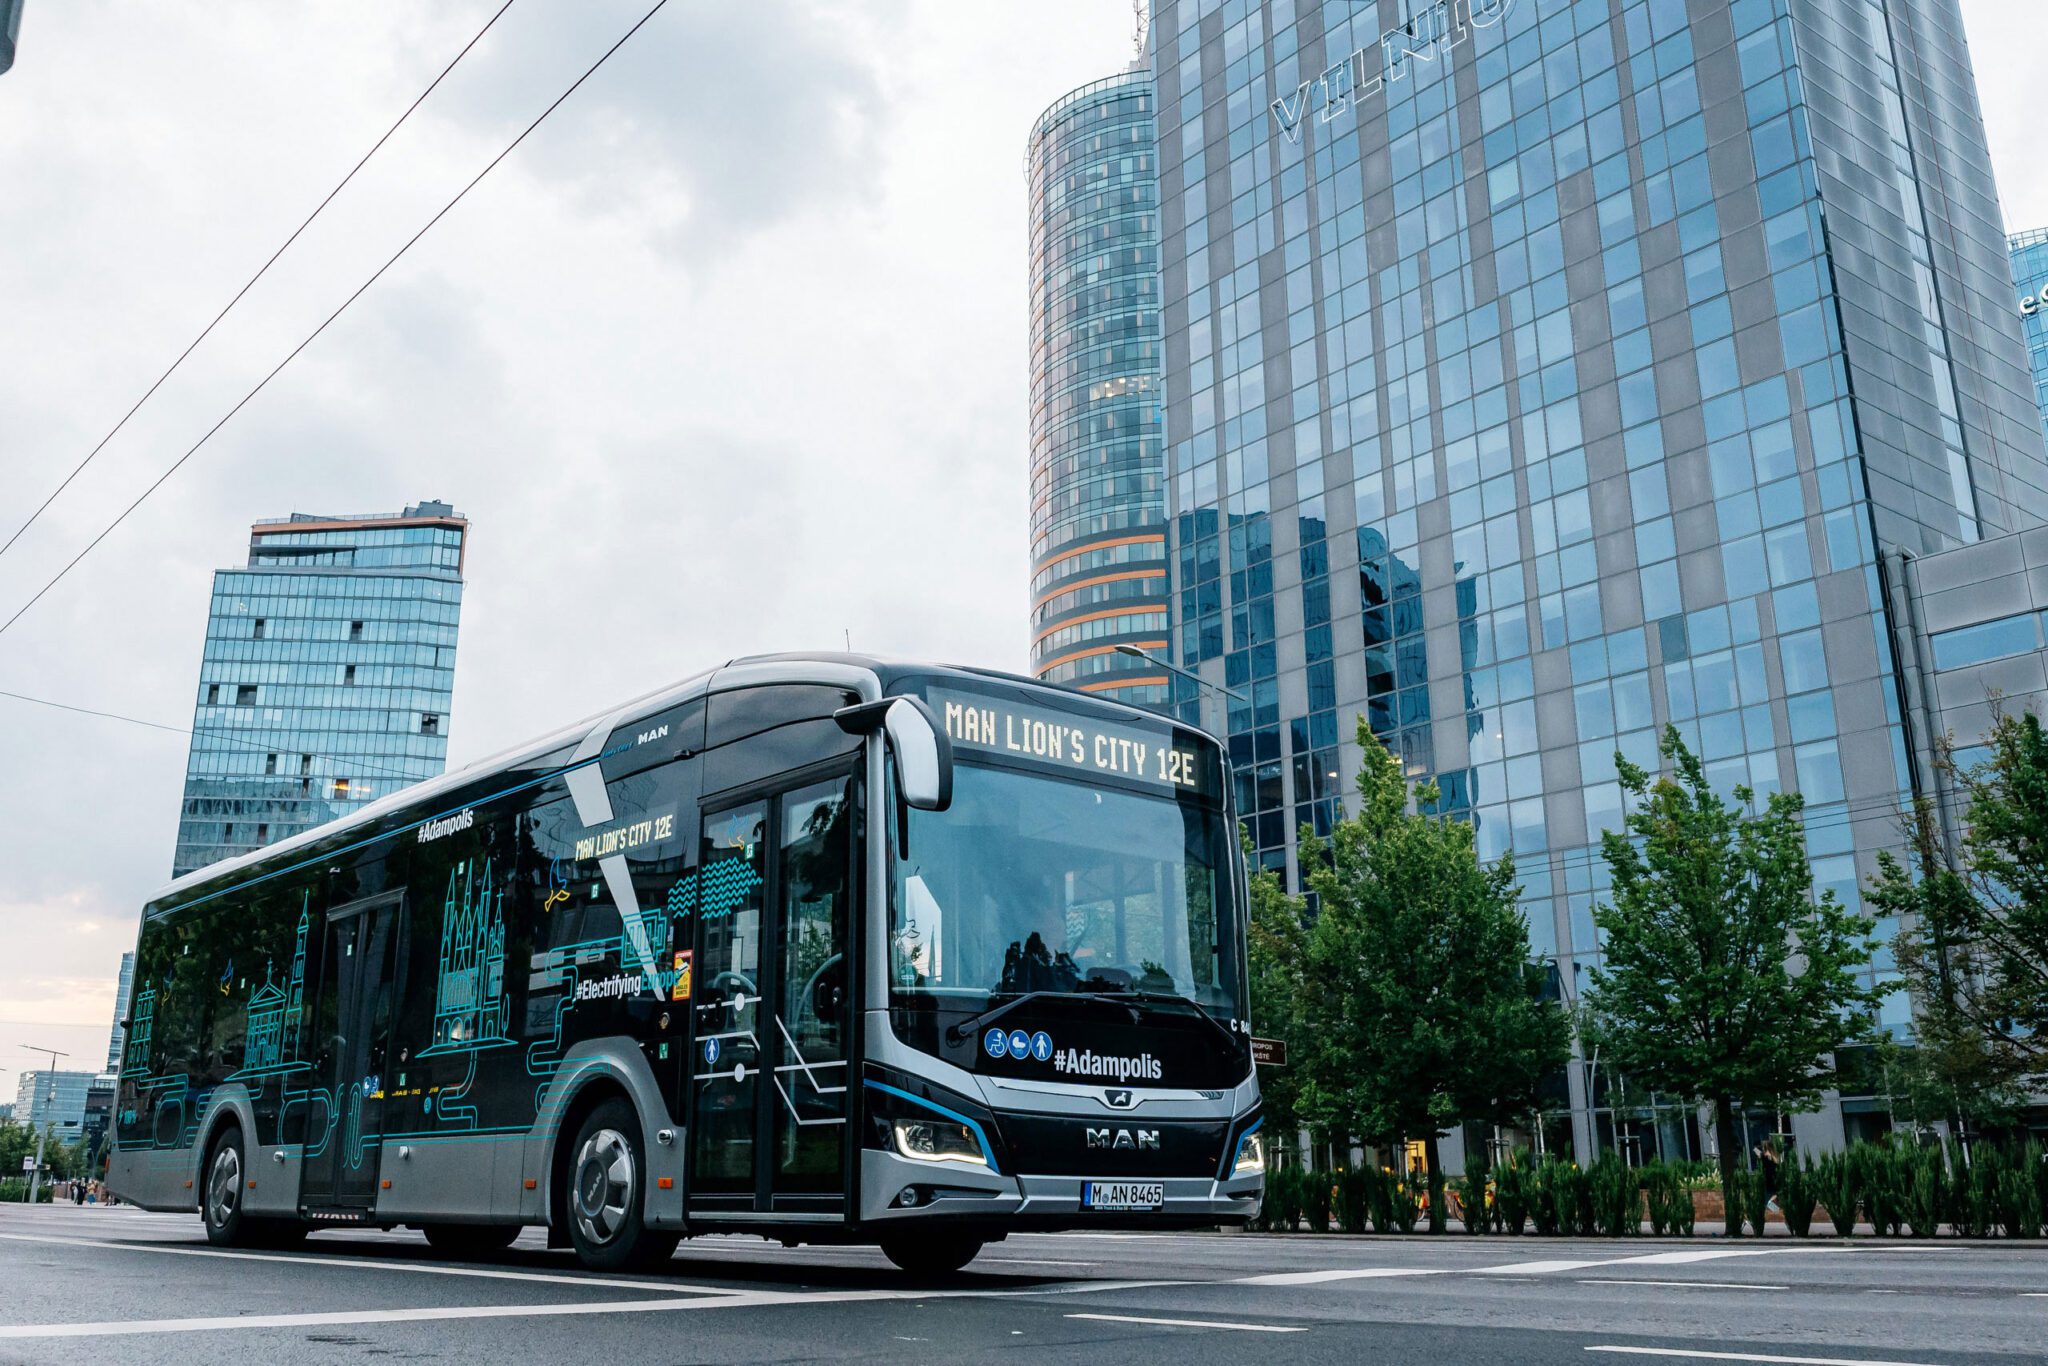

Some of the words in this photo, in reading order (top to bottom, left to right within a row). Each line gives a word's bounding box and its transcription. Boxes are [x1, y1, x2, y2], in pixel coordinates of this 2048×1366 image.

[638, 724, 669, 745] MAN
[945, 702, 996, 746] MAN
[1006, 714, 1084, 764] LION'S
[1094, 734, 1146, 775] CITY
[1156, 748, 1195, 786] 12E
[418, 808, 474, 843] #Adampolis
[575, 837, 595, 861] MAN
[596, 827, 627, 856] LION'S
[628, 820, 652, 847] CITY
[654, 814, 673, 840] 12E
[1252, 1042, 1273, 1051] ROPOS
[1054, 1047, 1162, 1082] #Adampolis
[1086, 1128, 1160, 1150] MAN
[587, 1172, 602, 1202] MAN
[1092, 1185, 1102, 1203] M
[1110, 1185, 1128, 1204] AN
[1130, 1185, 1162, 1204] 8465
